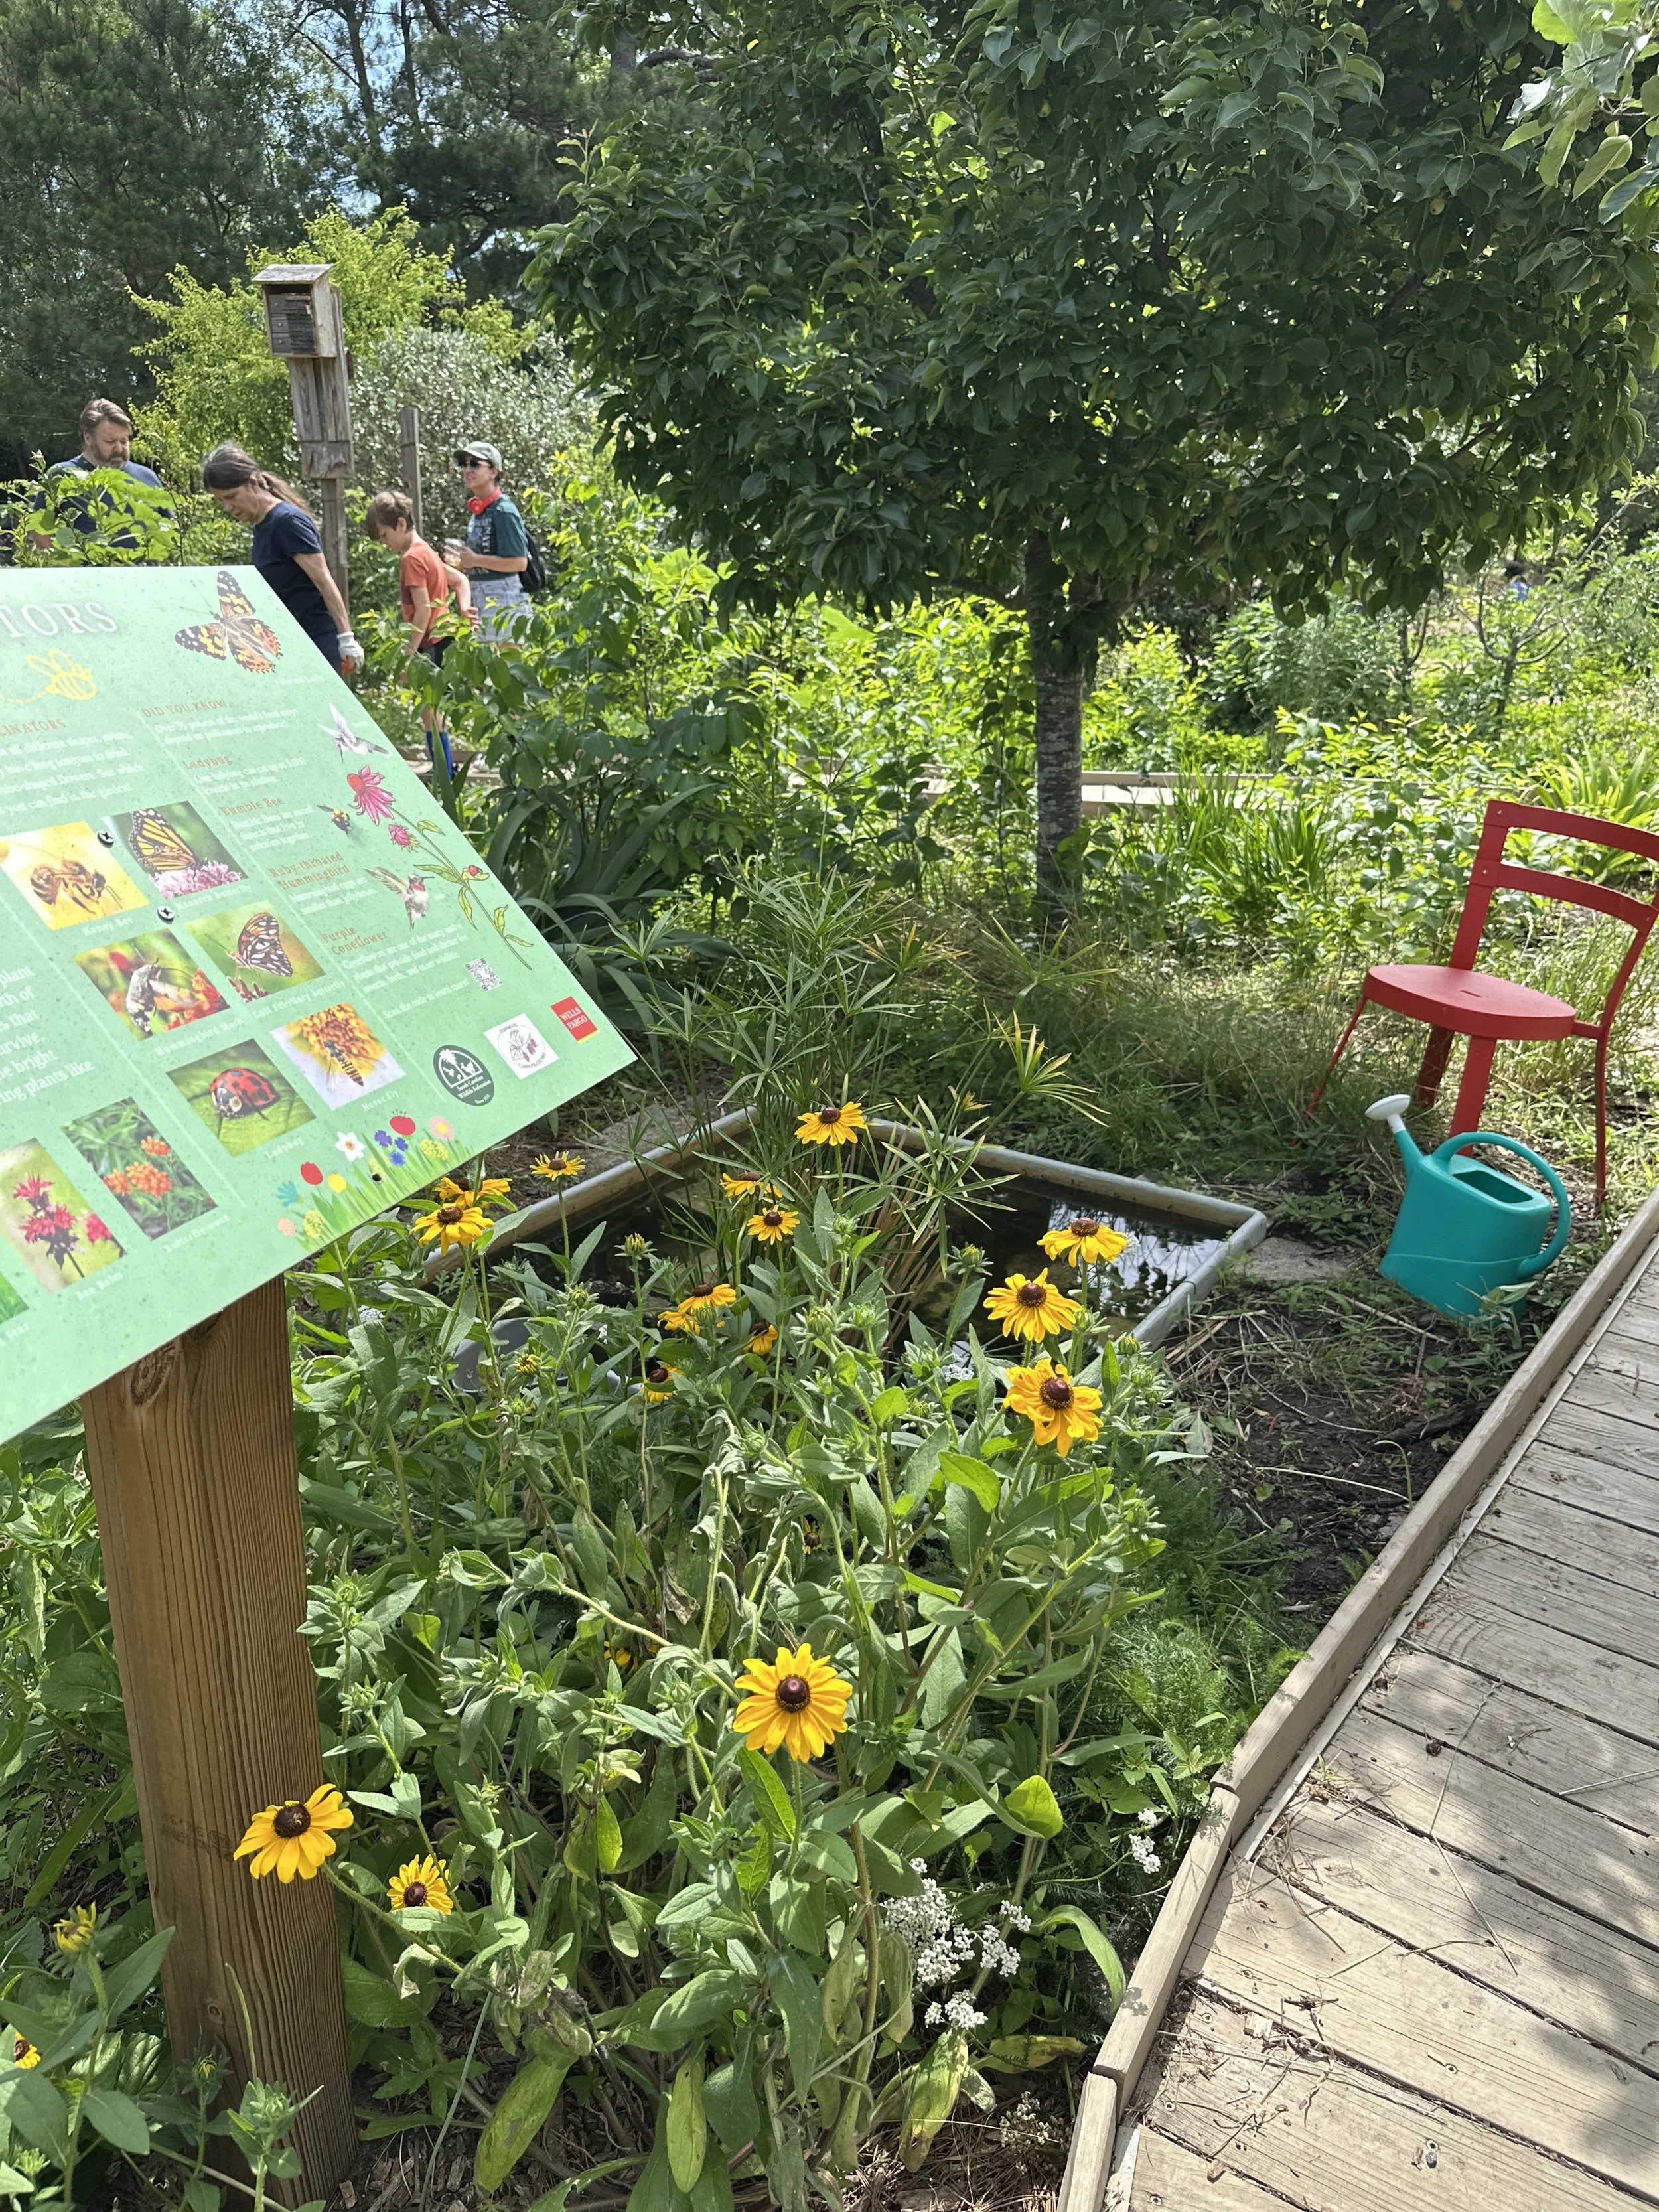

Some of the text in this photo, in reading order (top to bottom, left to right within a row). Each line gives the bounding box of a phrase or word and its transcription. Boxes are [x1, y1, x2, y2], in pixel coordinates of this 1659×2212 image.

[0, 602, 117, 637] TORS
[141, 700, 227, 718] DID YOU KNOW
[163, 733, 194, 745] depend
[29, 761, 57, 770] long
[92, 751, 105, 760] to
[105, 747, 130, 758] drink
[182, 756, 233, 769] Ladybug
[96, 769, 116, 777] See
[219, 798, 283, 816] Bumble Bee
[269, 852, 343, 877] Ruby-throated
[277, 864, 350, 890] Hummingbird
[174, 884, 252, 910] Monarch Butterfly
[289, 883, 340, 903] Hummingbird
[339, 880, 356, 890] eggs
[301, 902, 327, 914] smaller
[326, 898, 343, 907] than
[82, 917, 133, 936] Honey Bee
[321, 927, 357, 943] Purple
[331, 932, 388, 956] Coneflower
[342, 950, 387, 970] Coneflowers
[386, 946, 397, 955] are
[397, 942, 410, 950] one
[409, 936, 417, 946] of
[415, 934, 428, 943] the
[427, 930, 445, 939] many
[353, 969, 375, 983] plants
[373, 963, 388, 974] that
[411, 948, 428, 959] food
[427, 943, 439, 954] and
[438, 938, 459, 949] shelter
[406, 966, 419, 976] and
[418, 960, 435, 971] other
[19, 986, 35, 1001] of
[382, 1007, 401, 1019] Scan
[398, 1003, 412, 1012] the
[411, 996, 427, 1007] code
[432, 987, 452, 997] learn
[451, 978, 469, 991] more!
[9, 1009, 39, 1026] that
[252, 1006, 272, 1019] Gulf
[559, 1007, 581, 1021] WELLS
[567, 1015, 588, 1029] FARGO
[10, 1049, 58, 1073] bright
[23, 1070, 68, 1097] plants
[64, 1061, 94, 1077] like
[457, 1076, 484, 1092] South Carolina
[457, 1080, 492, 1098] Wildlife Federation
[361, 1090, 399, 1111] Hover Fly
[265, 1137, 305, 1159] Ladybug
